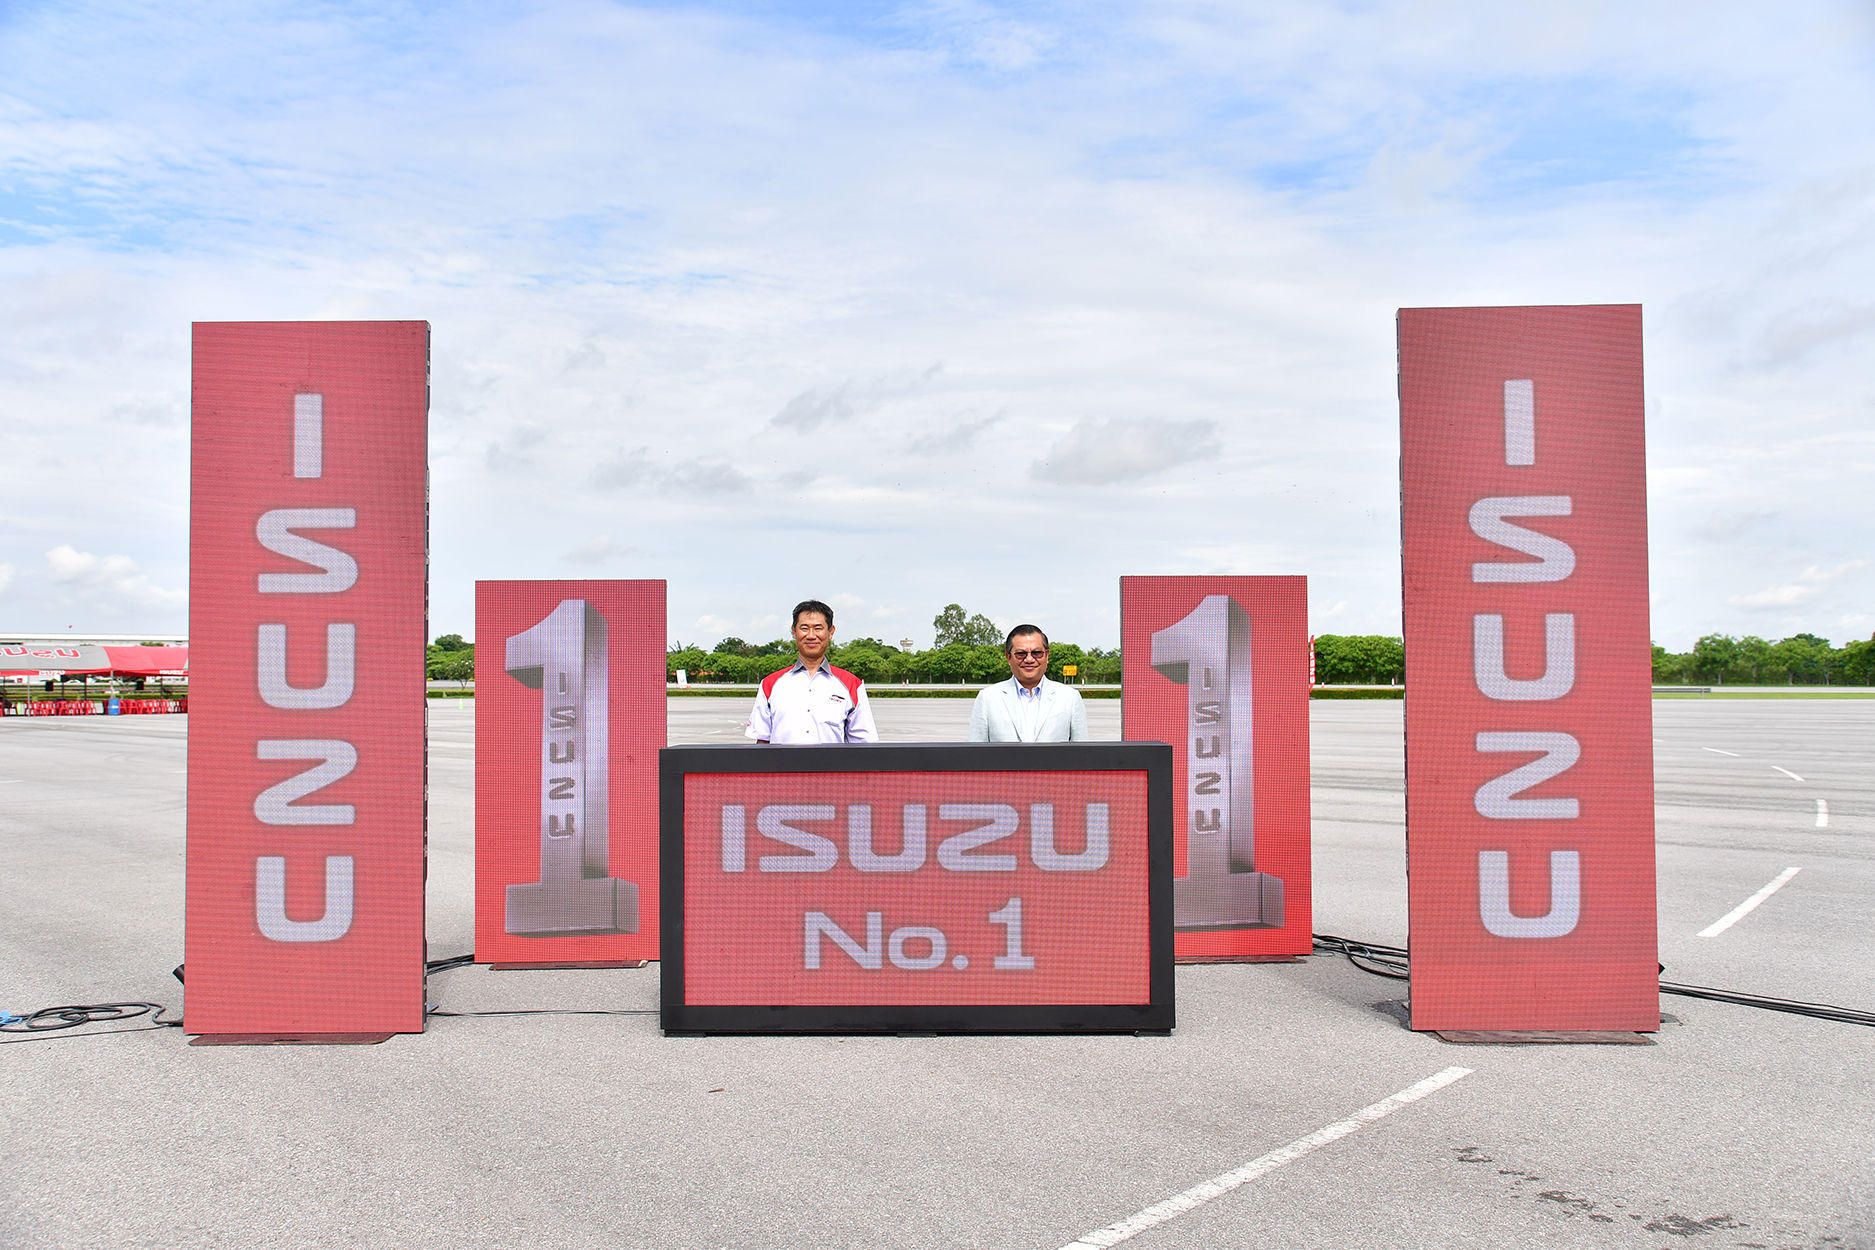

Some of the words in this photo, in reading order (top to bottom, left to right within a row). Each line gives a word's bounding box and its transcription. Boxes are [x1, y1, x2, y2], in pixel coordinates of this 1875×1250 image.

[0, 646, 80, 659] UZU
[254, 393, 358, 942] ISUZU
[1468, 379, 1582, 938] ISUZU
[504, 599, 640, 937] 1
[548, 671, 577, 839] ISUZU
[1151, 595, 1285, 931] 1
[1194, 667, 1222, 834] ISUZU
[721, 802, 1110, 873] ISUZU
[804, 911, 969, 971] No.
[988, 897, 1036, 970] 1
